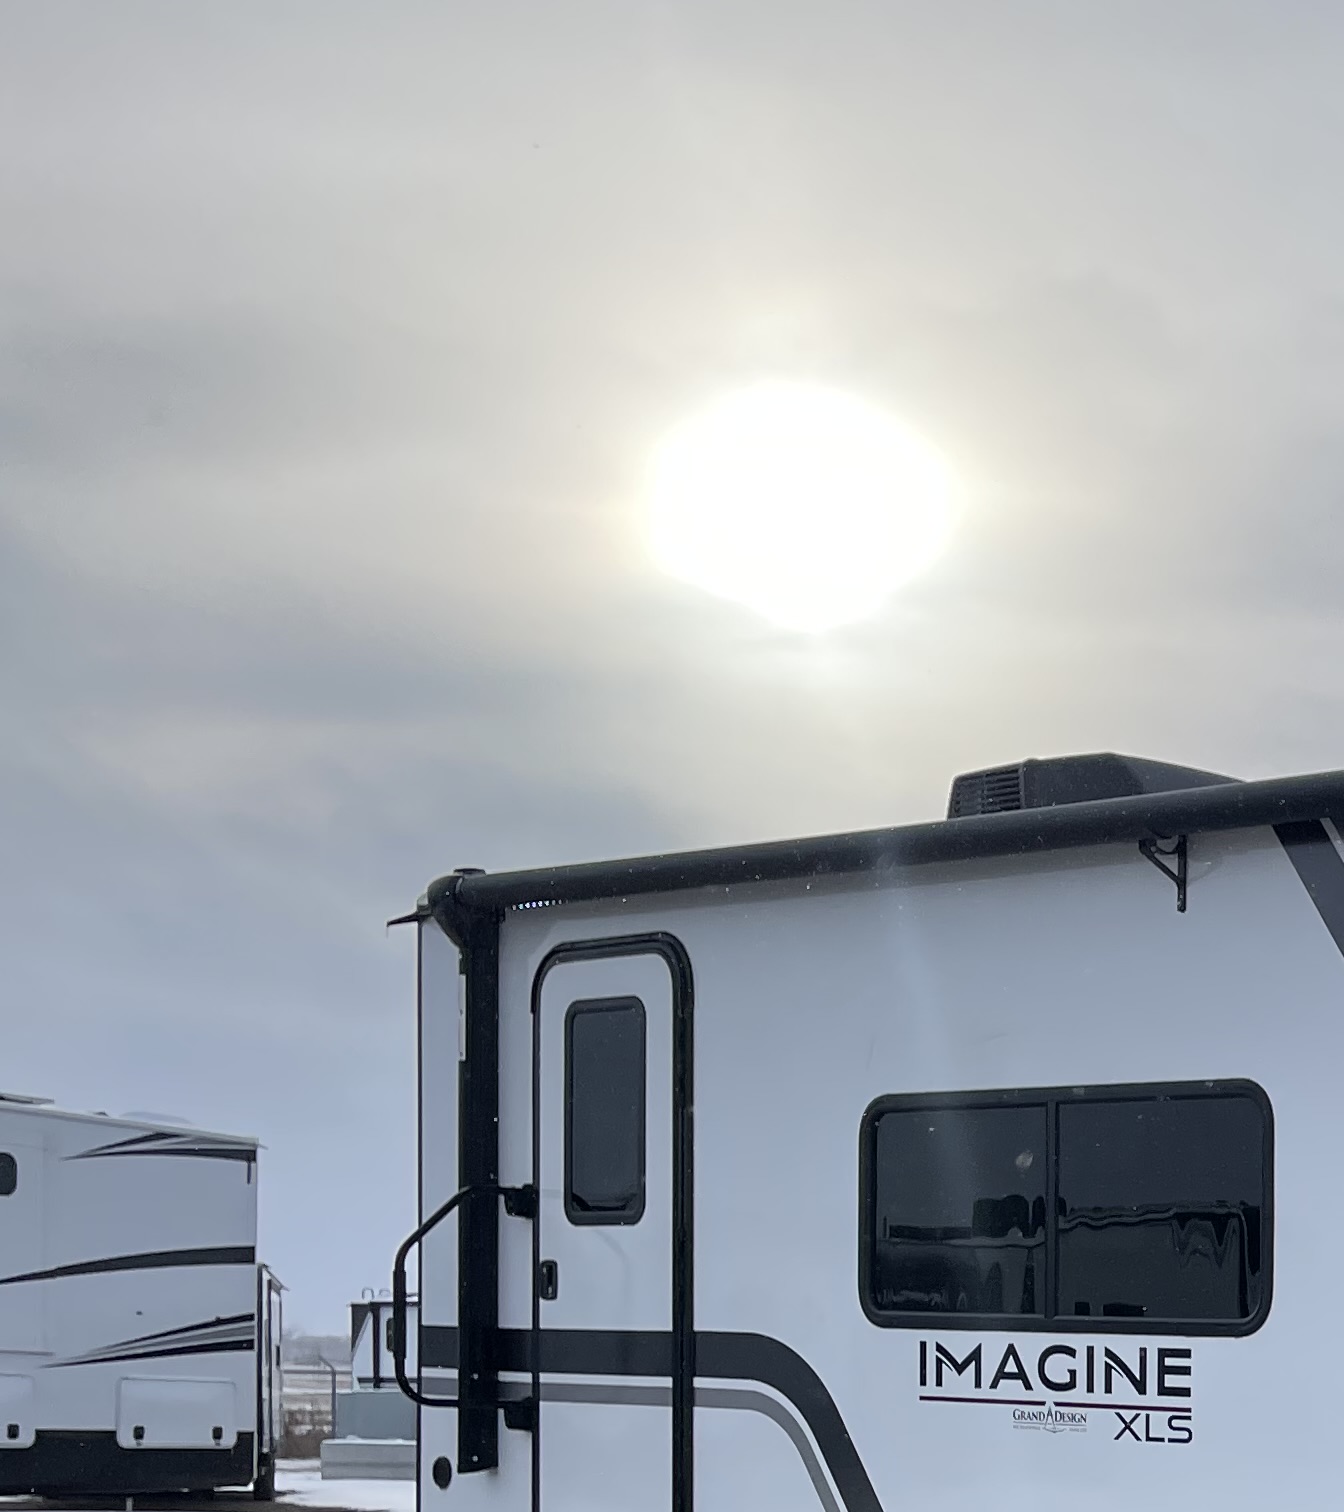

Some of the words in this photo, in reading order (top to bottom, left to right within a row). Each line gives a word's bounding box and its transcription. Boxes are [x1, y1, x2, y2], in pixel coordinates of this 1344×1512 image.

[919, 1340, 1192, 1398] IMAGINE
[1012, 1408, 1046, 1422] GRAND
[1054, 1410, 1088, 1424] DESIGN
[1113, 1411, 1193, 1444] XLS
